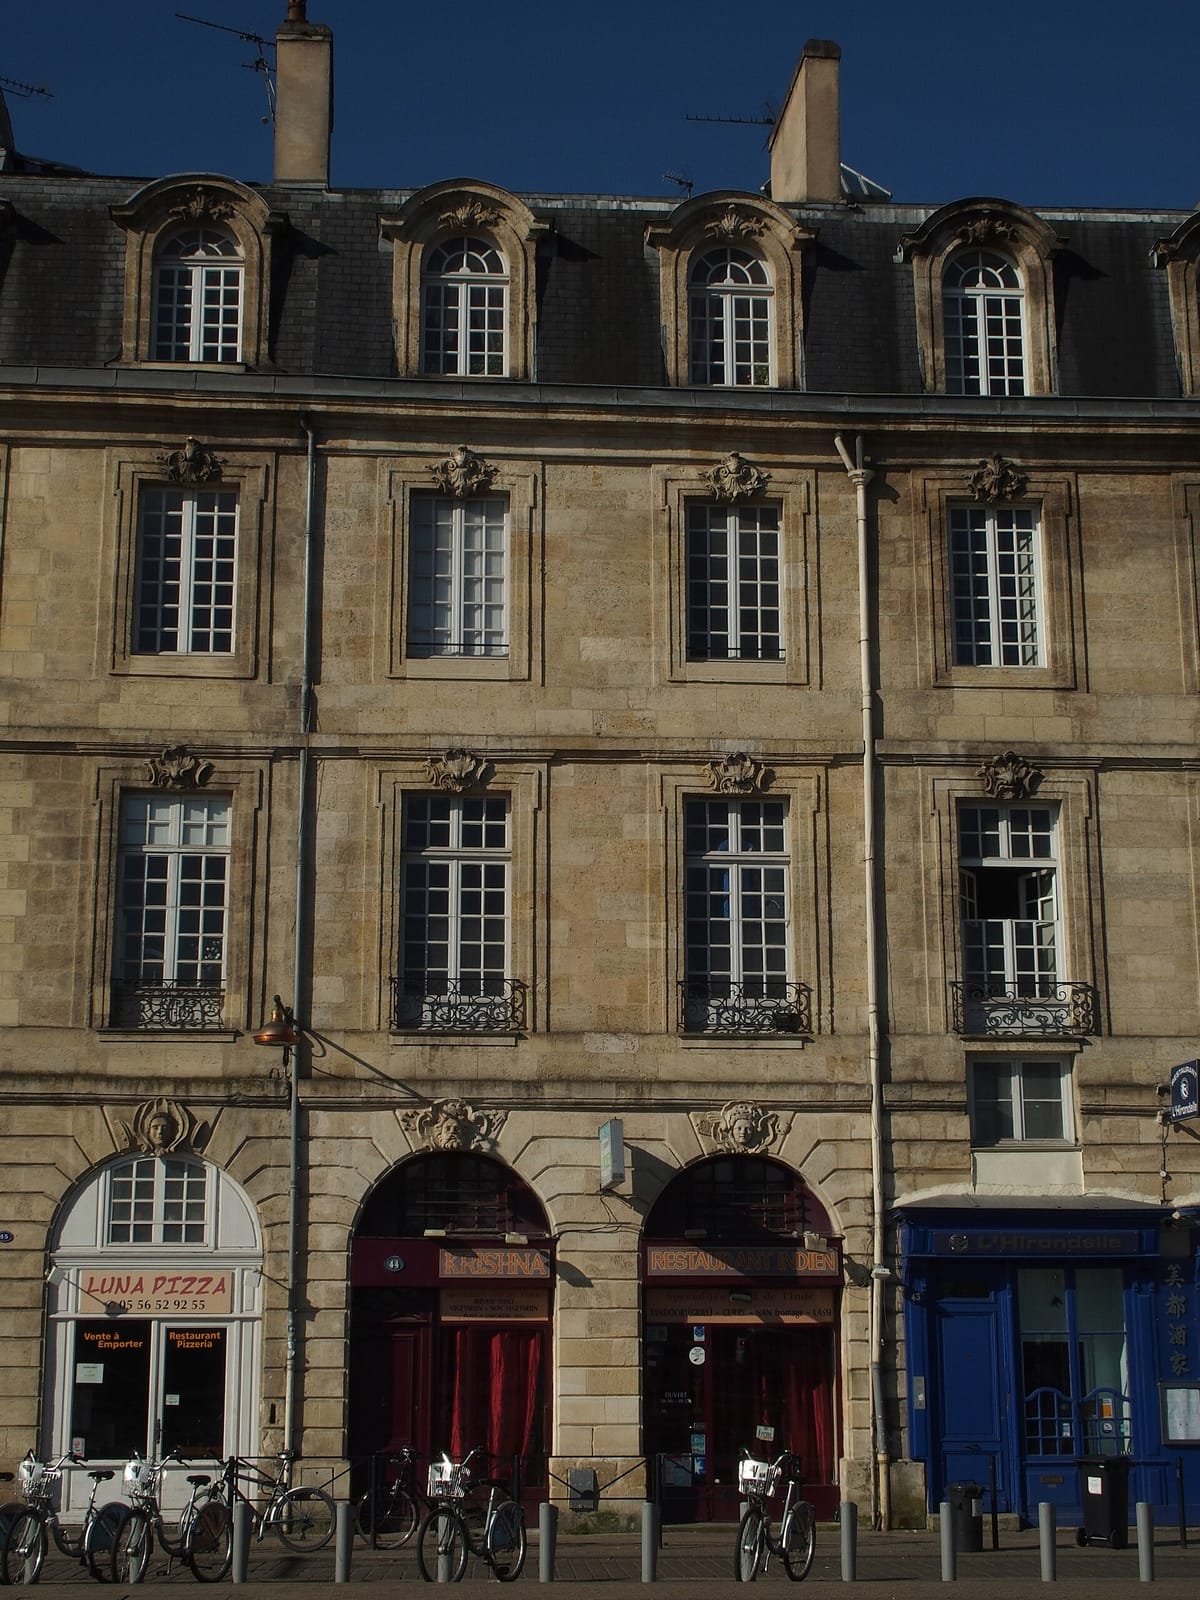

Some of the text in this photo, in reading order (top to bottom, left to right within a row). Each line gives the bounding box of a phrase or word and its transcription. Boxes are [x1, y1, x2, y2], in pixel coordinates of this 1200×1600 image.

[977, 1234, 1122, 1249] L'Hirondelle
[445, 1253, 547, 1275] KRISHNA
[651, 1251, 836, 1270] RESTAURANT INDIEN
[87, 1275, 226, 1295] LUNA PIZZA
[136, 1300, 151, 1310] 56
[155, 1300, 169, 1310] 52
[173, 1300, 187, 1310] 92
[191, 1300, 205, 1310] 55
[83, 1331, 120, 1341] Vente à
[169, 1331, 222, 1340] Restaurant
[97, 1340, 144, 1349] Emporter
[176, 1340, 214, 1349] Pizzeria
